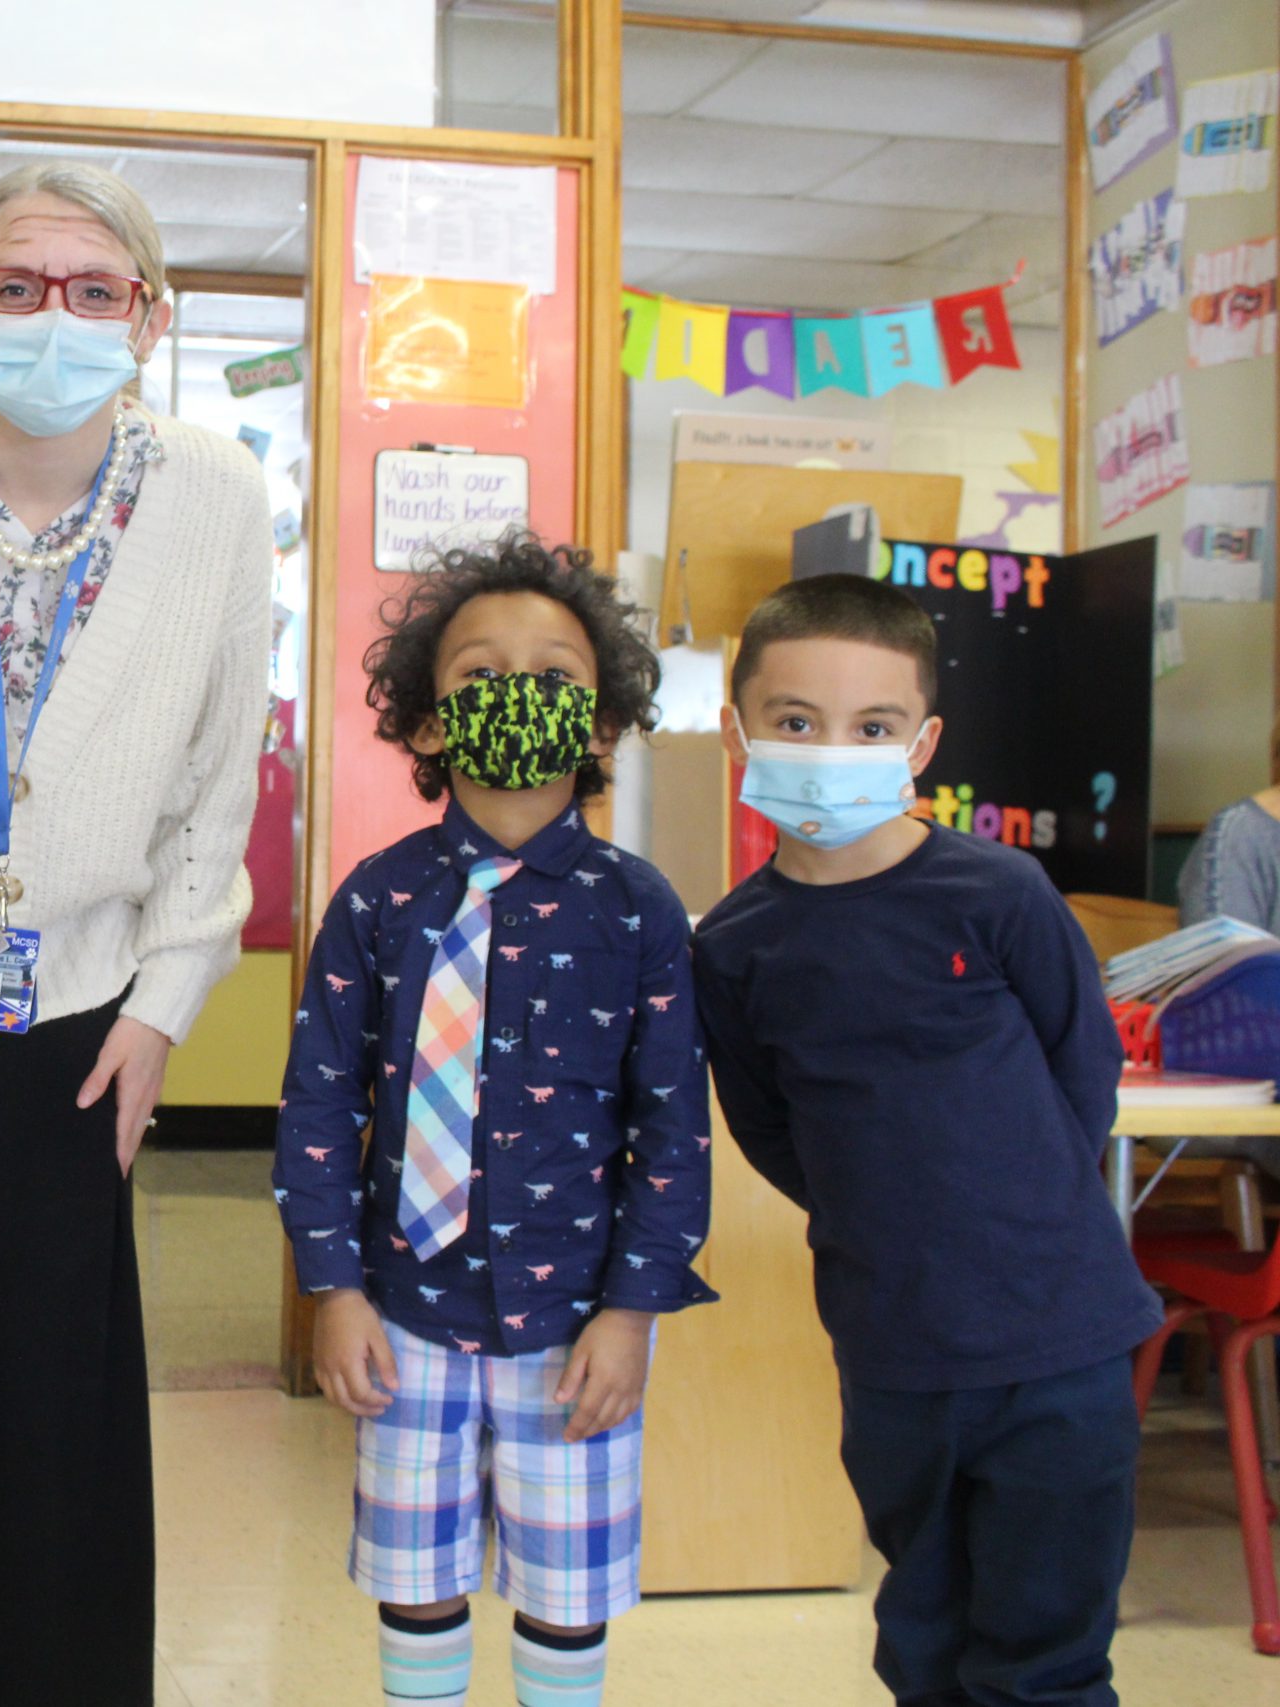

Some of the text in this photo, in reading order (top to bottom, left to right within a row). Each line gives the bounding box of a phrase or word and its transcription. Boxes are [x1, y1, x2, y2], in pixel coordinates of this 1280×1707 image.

[463, 473, 508, 493] our
[384, 493, 523, 523] hands before
[11, 937, 39, 948] MCSD
